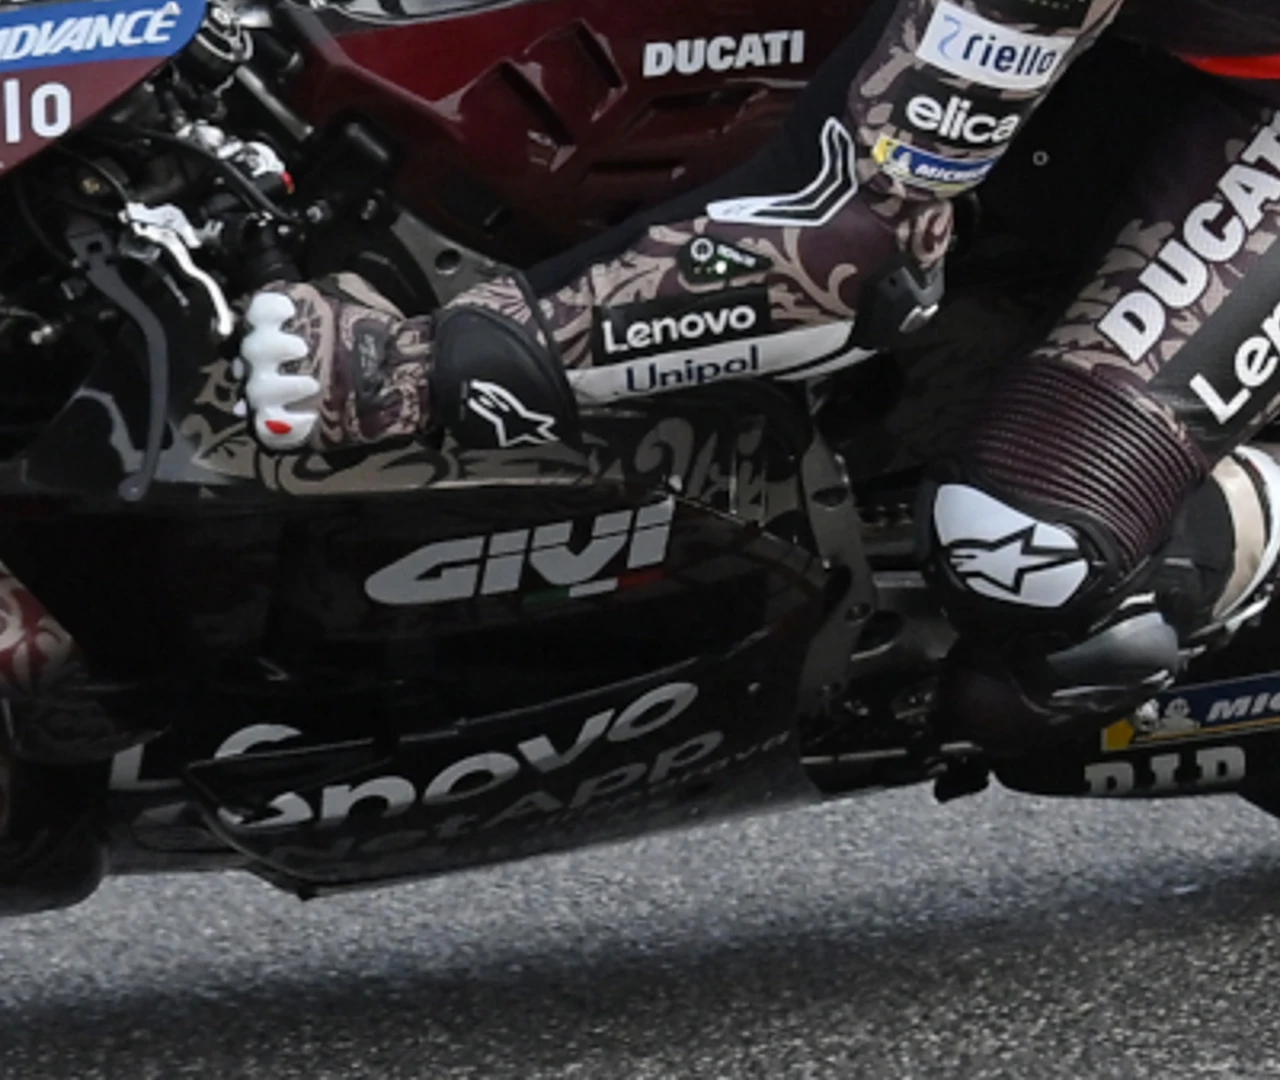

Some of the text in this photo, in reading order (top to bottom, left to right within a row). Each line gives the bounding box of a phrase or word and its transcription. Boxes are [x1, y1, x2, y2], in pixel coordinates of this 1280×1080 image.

[643, 29, 806, 80] DUCATI
[963, 31, 1058, 76] riello
[907, 92, 1020, 146] elica
[602, 304, 756, 353] Lenovo
[626, 345, 760, 392] Unipol
[365, 496, 677, 605] GIVI
